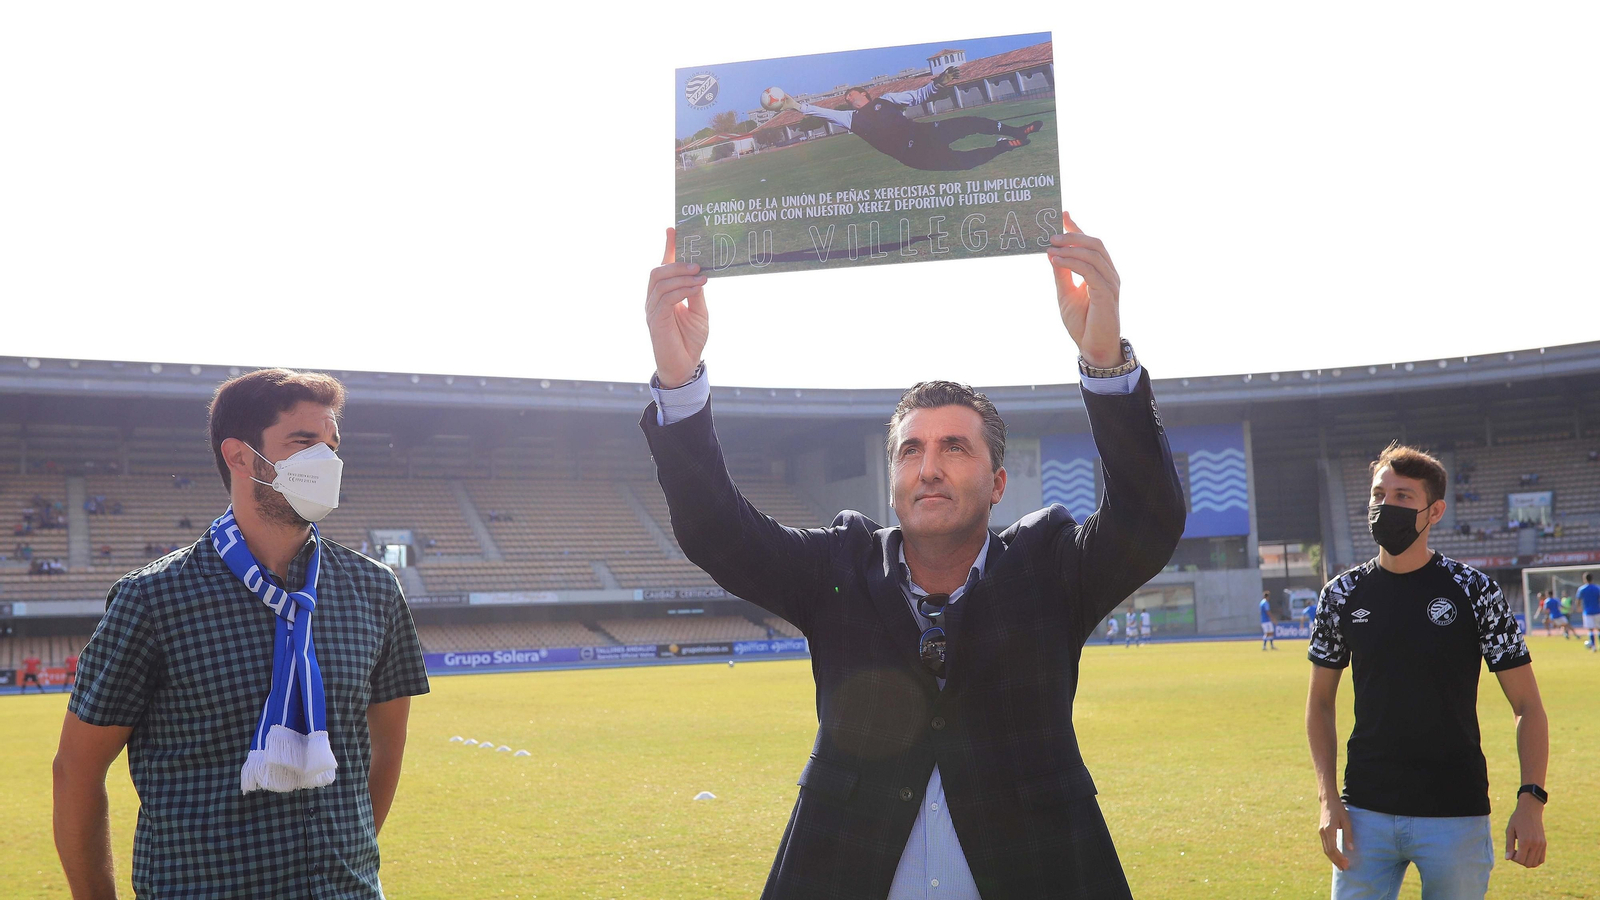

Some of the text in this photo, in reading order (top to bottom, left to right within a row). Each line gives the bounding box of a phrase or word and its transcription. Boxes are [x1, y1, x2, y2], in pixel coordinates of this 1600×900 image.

[681, 173, 1055, 216] CON CARIÑO DE LA UNIÓN DE PEÑAS XERECISTAS POR TU IMPLICACIÓN
[703, 189, 1032, 227] Y DEDICACIÓN CON NUESTRO XEREZ DEPORTIVO FÚTBOL CLUB
[808, 208, 1058, 263] VILLEGAS
[1275, 624, 1297, 637] Diario
[444, 652, 491, 667] Grupo
